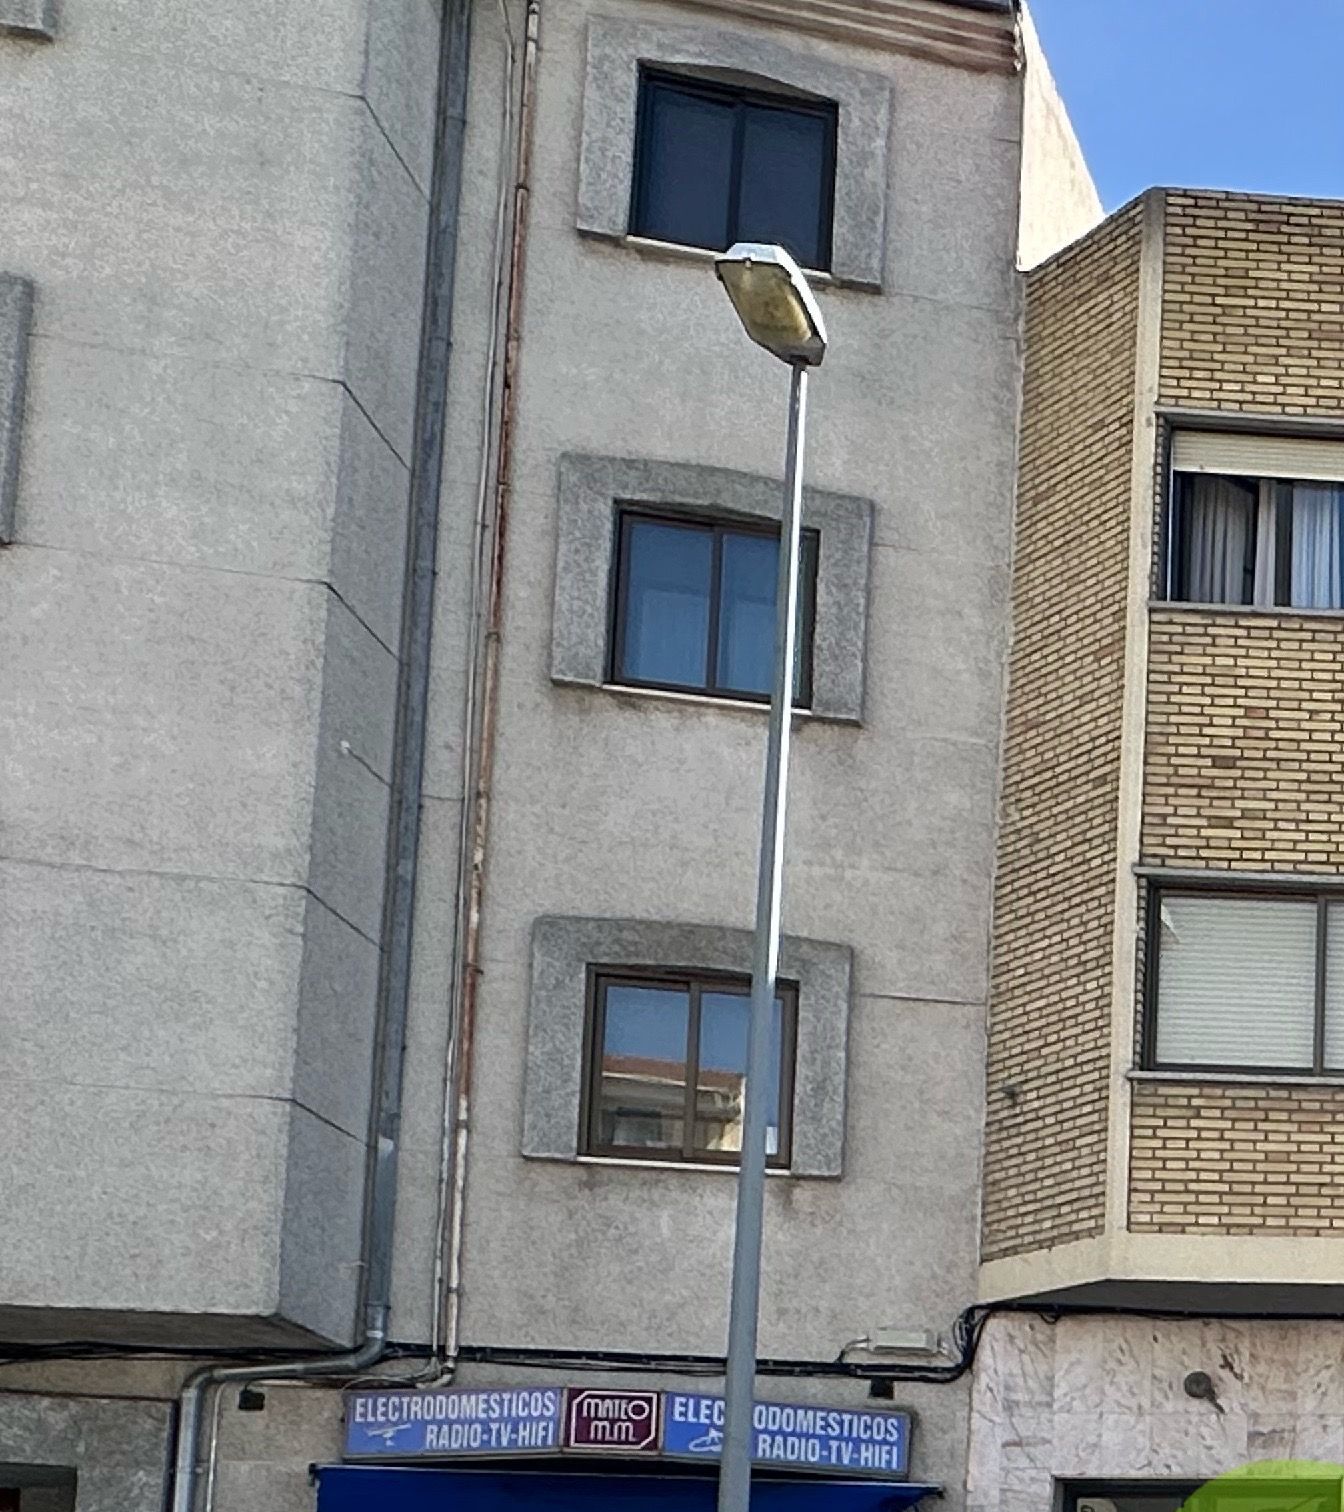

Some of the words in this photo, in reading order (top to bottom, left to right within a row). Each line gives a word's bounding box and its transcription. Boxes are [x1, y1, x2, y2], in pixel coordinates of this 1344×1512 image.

[354, 1391, 556, 1422] ELECTRODOMESTICOS
[582, 1399, 649, 1420] MATEO
[672, 1396, 899, 1442] ELECODOMESTICOS
[425, 1421, 554, 1450] RADIO-TV-HIFI
[757, 1433, 898, 1470] RADIO-TV-HIFI
